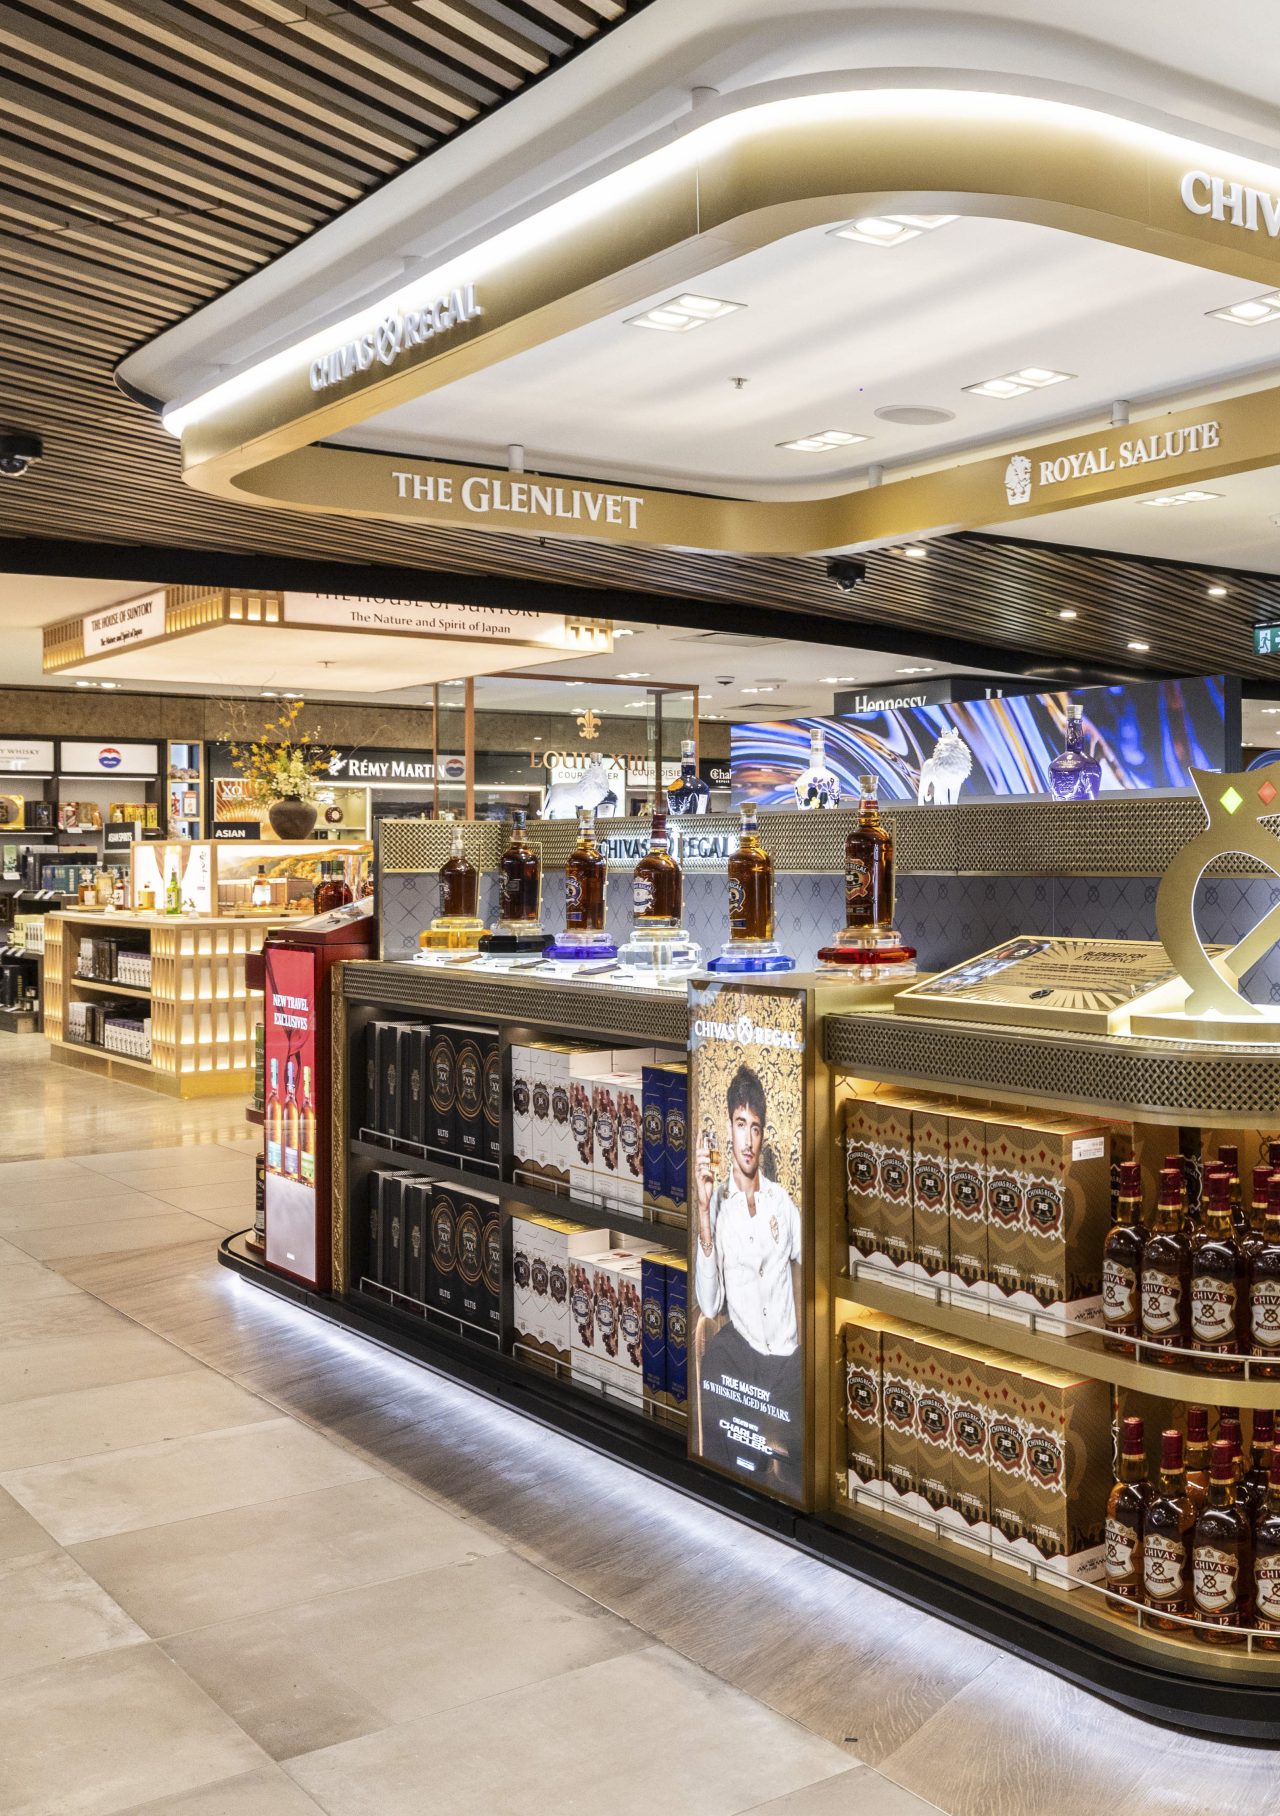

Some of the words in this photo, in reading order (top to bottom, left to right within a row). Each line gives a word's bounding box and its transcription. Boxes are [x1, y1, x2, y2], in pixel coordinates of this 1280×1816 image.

[309, 334, 376, 391] CHIVAS
[403, 282, 484, 350] REGAL
[1039, 447, 1115, 486] ROYAL
[1118, 420, 1222, 467] SALUTE
[392, 471, 453, 504] THE
[460, 475, 644, 530] GLENLIVET
[91, 619, 101, 632] THE
[101, 613, 119, 630] HOUSE
[119, 610, 127, 622] OF
[127, 601, 153, 620] SUNTORY
[350, 611, 371, 623] The
[374, 613, 413, 626] Nature
[415, 616, 436, 628] and
[438, 618, 466, 632] Spirit
[469, 620, 480, 632] of
[482, 622, 511, 635] Japan
[348, 758, 389, 777] RÉMY
[391, 760, 446, 779] MARTIN
[529, 750, 601, 769] LOUI
[609, 755, 646, 771] XIII
[215, 829, 246, 838] ASIAN
[599, 838, 648, 859] CHIVAS
[272, 993, 286, 1007] NEW
[287, 995, 309, 1012] TRAVEL
[273, 1012, 308, 1031] EXCLUSIVES
[694, 1020, 735, 1040] CHIVAS
[755, 1026, 800, 1049] REGAL
[437, 1128, 449, 1138] ULTIS
[463, 1135, 476, 1145] ULTIS
[951, 1173, 968, 1182] CHIVAS
[989, 1180, 1006, 1190] CHIVAS
[1027, 1188, 1044, 1198] CHIVAS
[464, 1298, 477, 1310] ULTIS
[1192, 1291, 1228, 1303] CHIVAS
[1163, 1338, 1173, 1347] 12
[703, 1379, 711, 1391] 16
[742, 1395, 760, 1410] AGED
[760, 1402, 767, 1413] 16
[721, 1374, 739, 1390] TRUE
[739, 1381, 771, 1402] MASTERY
[719, 1419, 767, 1446] CHARLES
[727, 1430, 773, 1456] LECLERC
[1028, 1438, 1044, 1447] CHIVAS
[1144, 1547, 1177, 1561] CHIVAS
[1119, 1586, 1128, 1595] 12
[1167, 1603, 1177, 1612] 12
